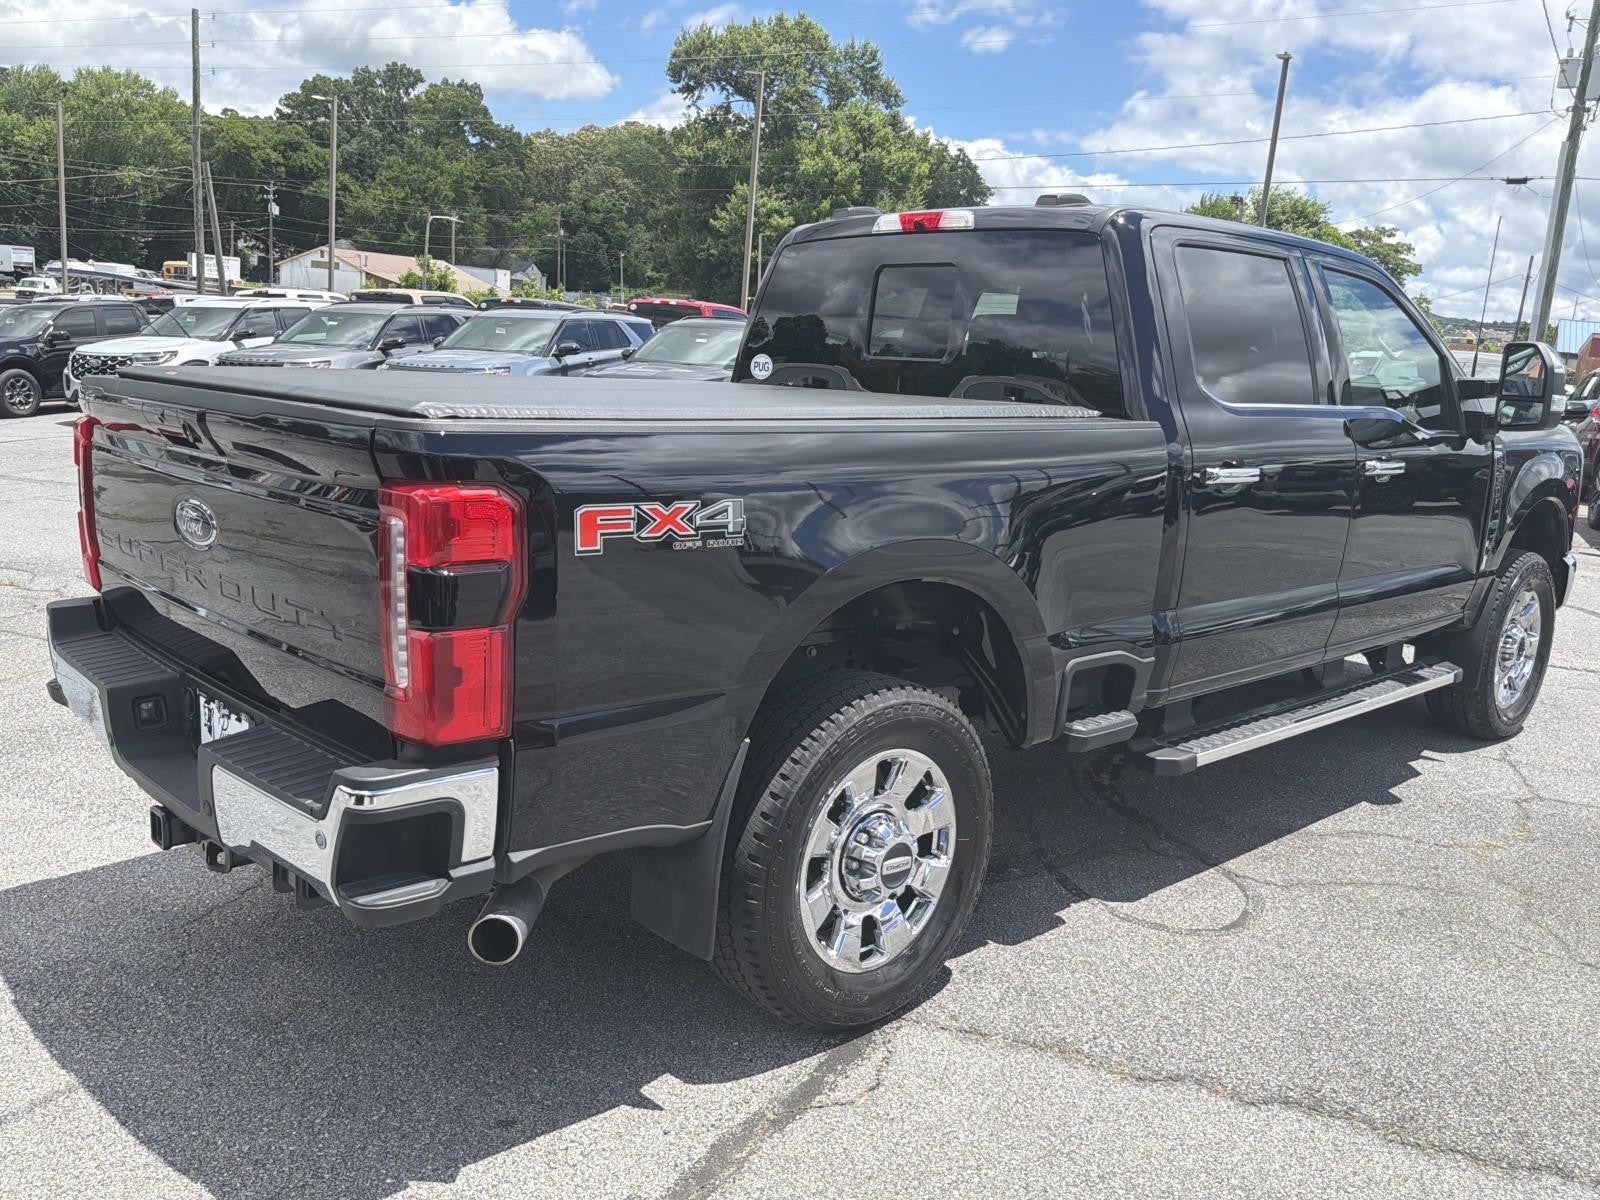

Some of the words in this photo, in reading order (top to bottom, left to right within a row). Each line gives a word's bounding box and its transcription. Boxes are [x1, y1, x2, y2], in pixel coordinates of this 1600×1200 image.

[753, 361, 770, 372] PUG
[574, 499, 746, 556] FX4
[673, 541, 702, 550] OFF
[707, 538, 745, 549] ROAD
[100, 527, 207, 589] SUPER
[219, 573, 355, 641] DUTY
[886, 862, 909, 871] FORD
